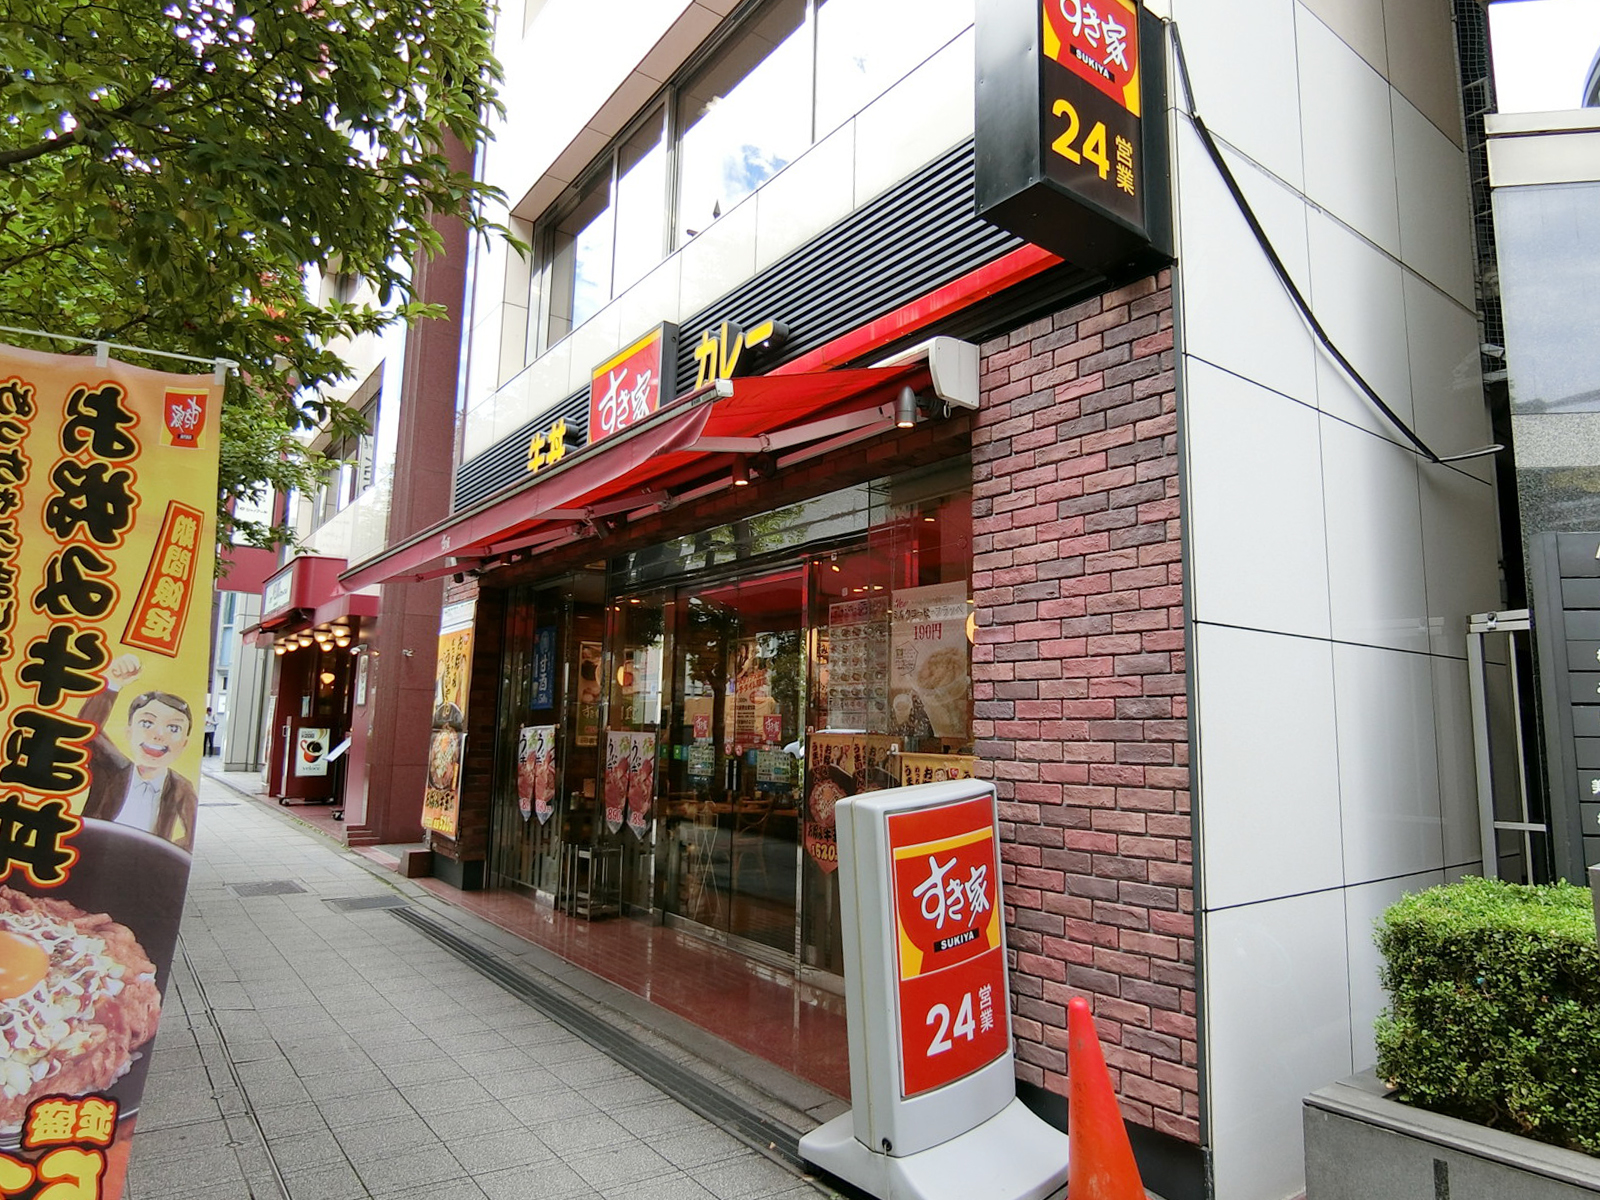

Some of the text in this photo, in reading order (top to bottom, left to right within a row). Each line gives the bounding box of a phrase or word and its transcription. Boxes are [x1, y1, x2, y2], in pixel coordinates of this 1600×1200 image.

[1075, 49, 1111, 80] SUKIYA
[1051, 98, 1136, 197] 24 営業
[693, 320, 774, 391] カレー
[598, 367, 653, 434] すき家
[527, 418, 567, 473] 牛丼
[914, 622, 942, 640] 190円
[912, 855, 990, 929] すき家
[940, 931, 975, 951] SUKIYA
[926, 983, 994, 1057] 24 営業
